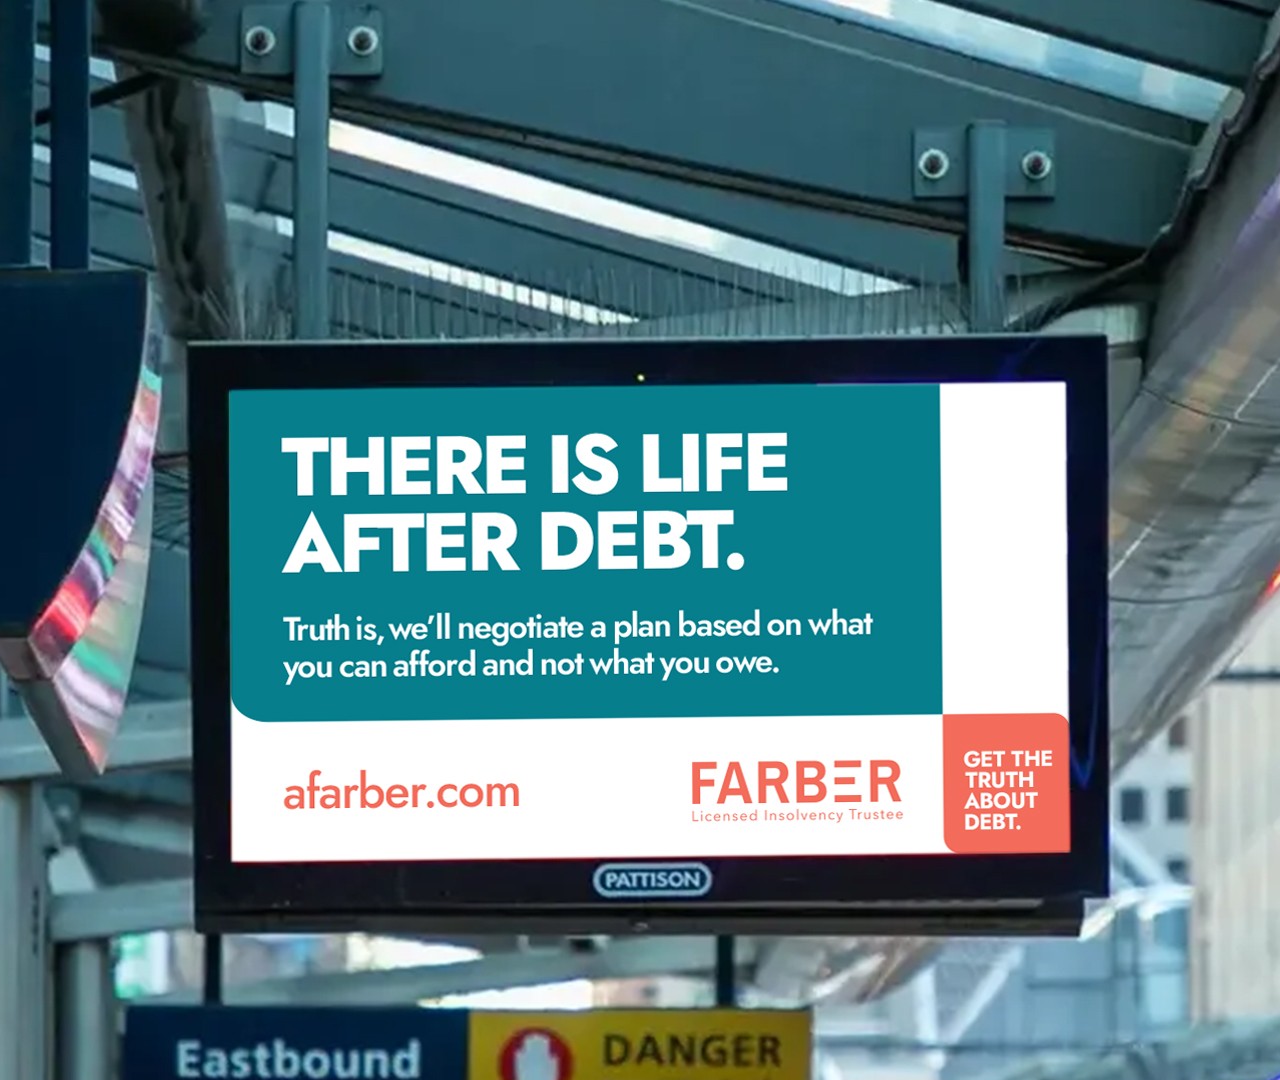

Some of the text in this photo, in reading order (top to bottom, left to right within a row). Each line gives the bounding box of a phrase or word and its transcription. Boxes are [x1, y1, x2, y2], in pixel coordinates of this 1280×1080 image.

[281, 432, 788, 496] THERE IS LIFE
[282, 509, 745, 574] AFTER DEBT.
[283, 607, 874, 647] Truth is, we’ll negotiate a plan based on what
[283, 647, 780, 686] you can afford and not what you owe.
[964, 749, 1053, 768] GET THE
[283, 769, 520, 810] afarber.com
[692, 759, 902, 804] FARBER
[964, 771, 1035, 788] TRUTH
[691, 807, 904, 824] Licensed Insolvency Trustee
[964, 791, 1039, 809] ABOUT
[964, 812, 1022, 831] DEBT.
[604, 872, 701, 890] PATTISON
[178, 1039, 420, 1079] Eastbound
[603, 1034, 782, 1068] DANGER
